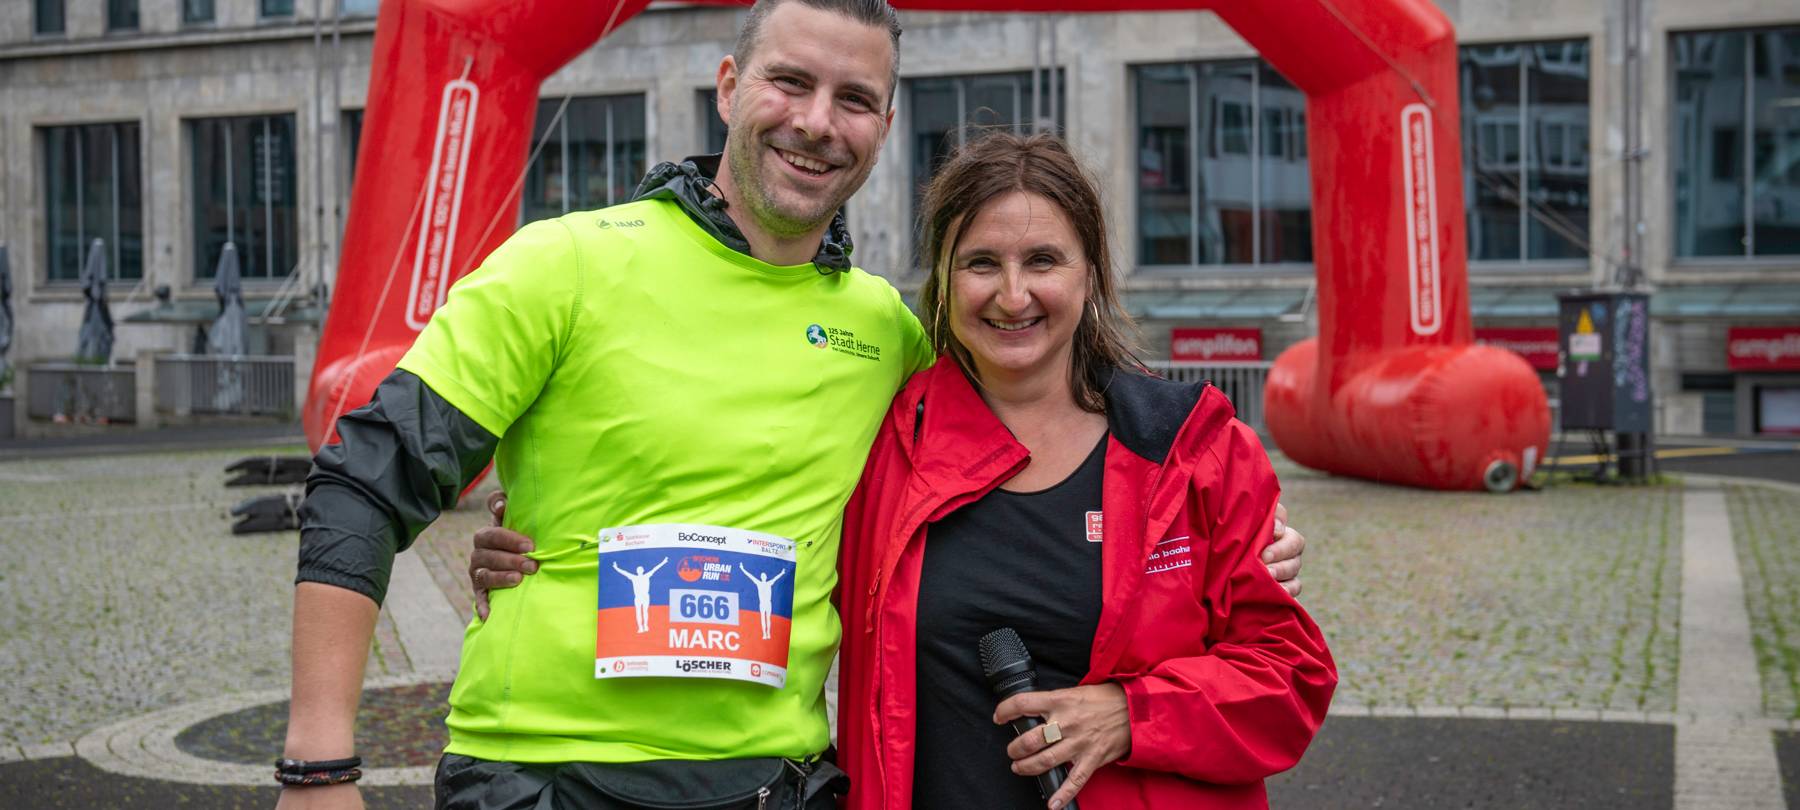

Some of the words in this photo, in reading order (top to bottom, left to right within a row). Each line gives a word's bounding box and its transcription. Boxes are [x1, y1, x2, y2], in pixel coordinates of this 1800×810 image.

[828, 327, 839, 335] 125
[839, 329, 854, 337] Jahre
[829, 334, 855, 350] Stadt
[856, 340, 881, 356] Herne
[1172, 333, 1259, 359] amplifon
[678, 532, 727, 545] BoConcept
[752, 539, 786, 549] INTERSPORT
[703, 562, 732, 574] URBAN
[702, 571, 720, 581] RUN
[680, 593, 730, 620] 666
[668, 628, 740, 652] MARC
[676, 660, 731, 673] LÖSCHER
